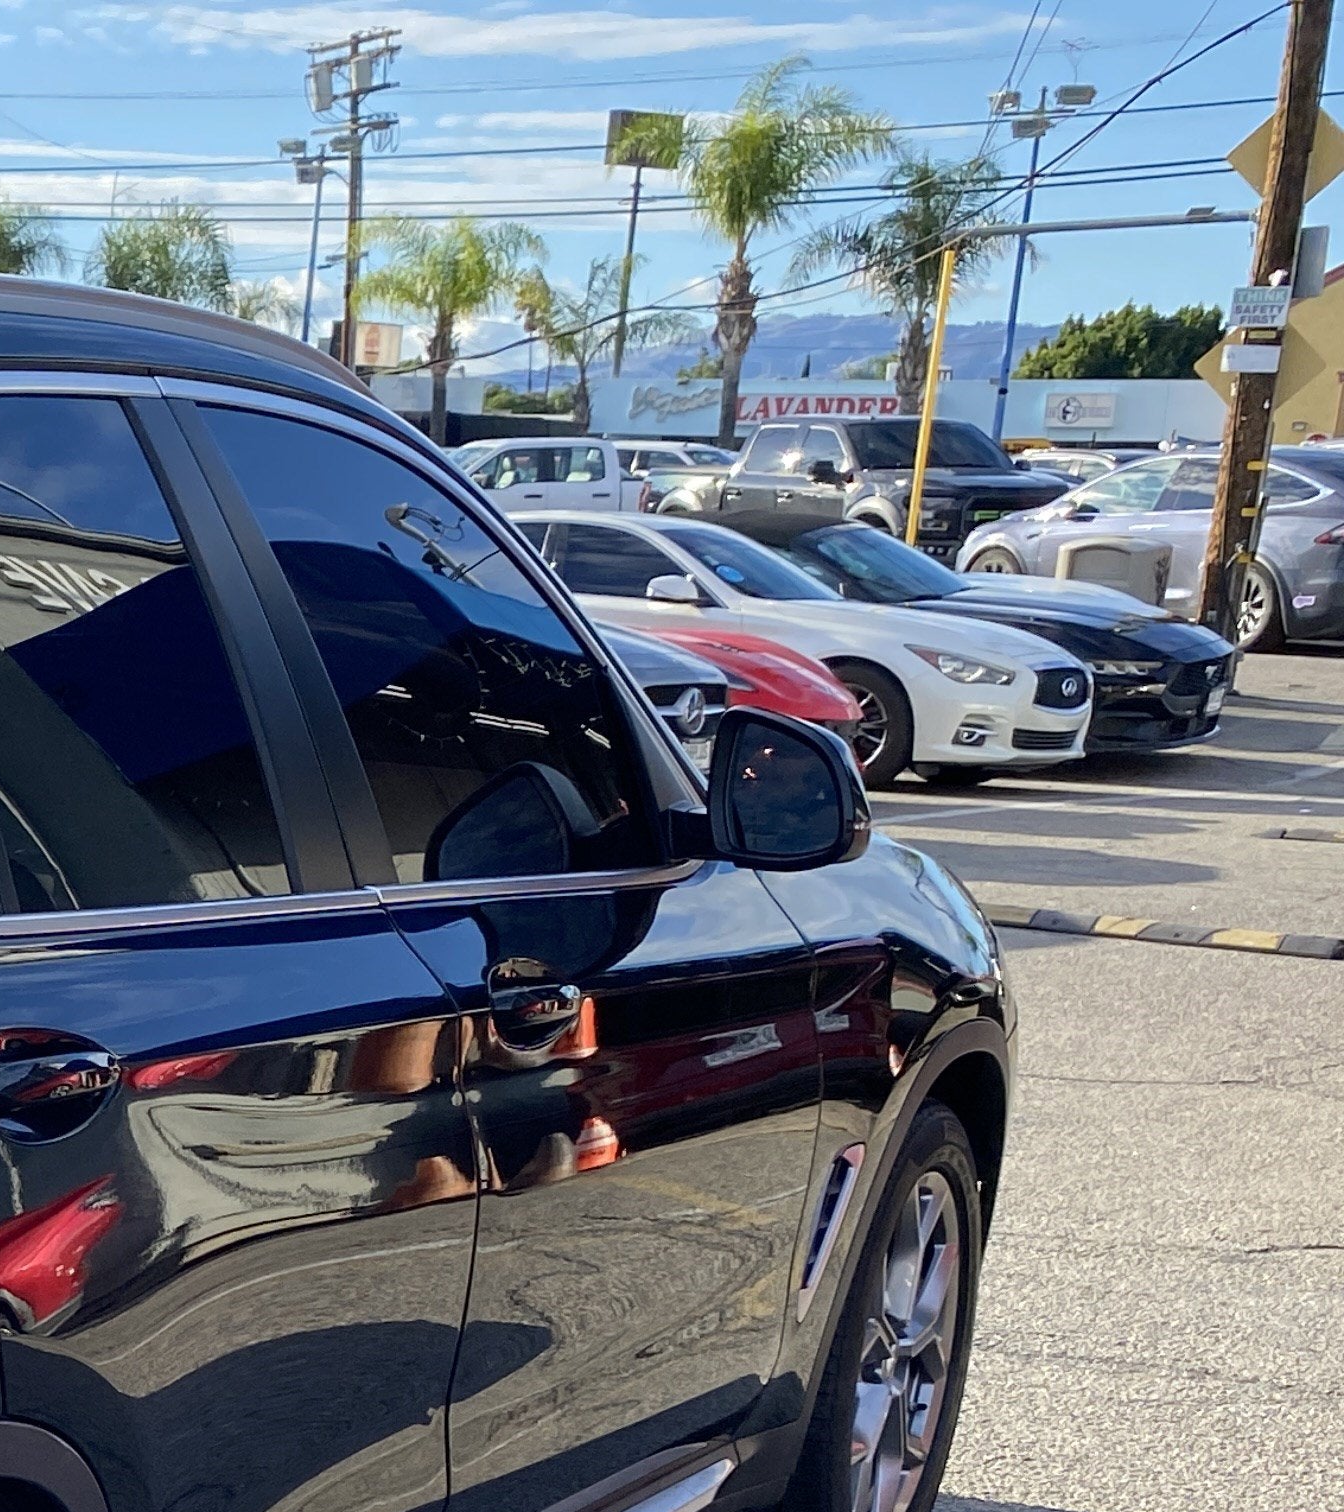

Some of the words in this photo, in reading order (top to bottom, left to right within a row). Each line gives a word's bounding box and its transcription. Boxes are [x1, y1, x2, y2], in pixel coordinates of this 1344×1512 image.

[1237, 289, 1286, 302] THINK
[1236, 305, 1284, 314] SAFETY
[1240, 316, 1276, 324] FIRST
